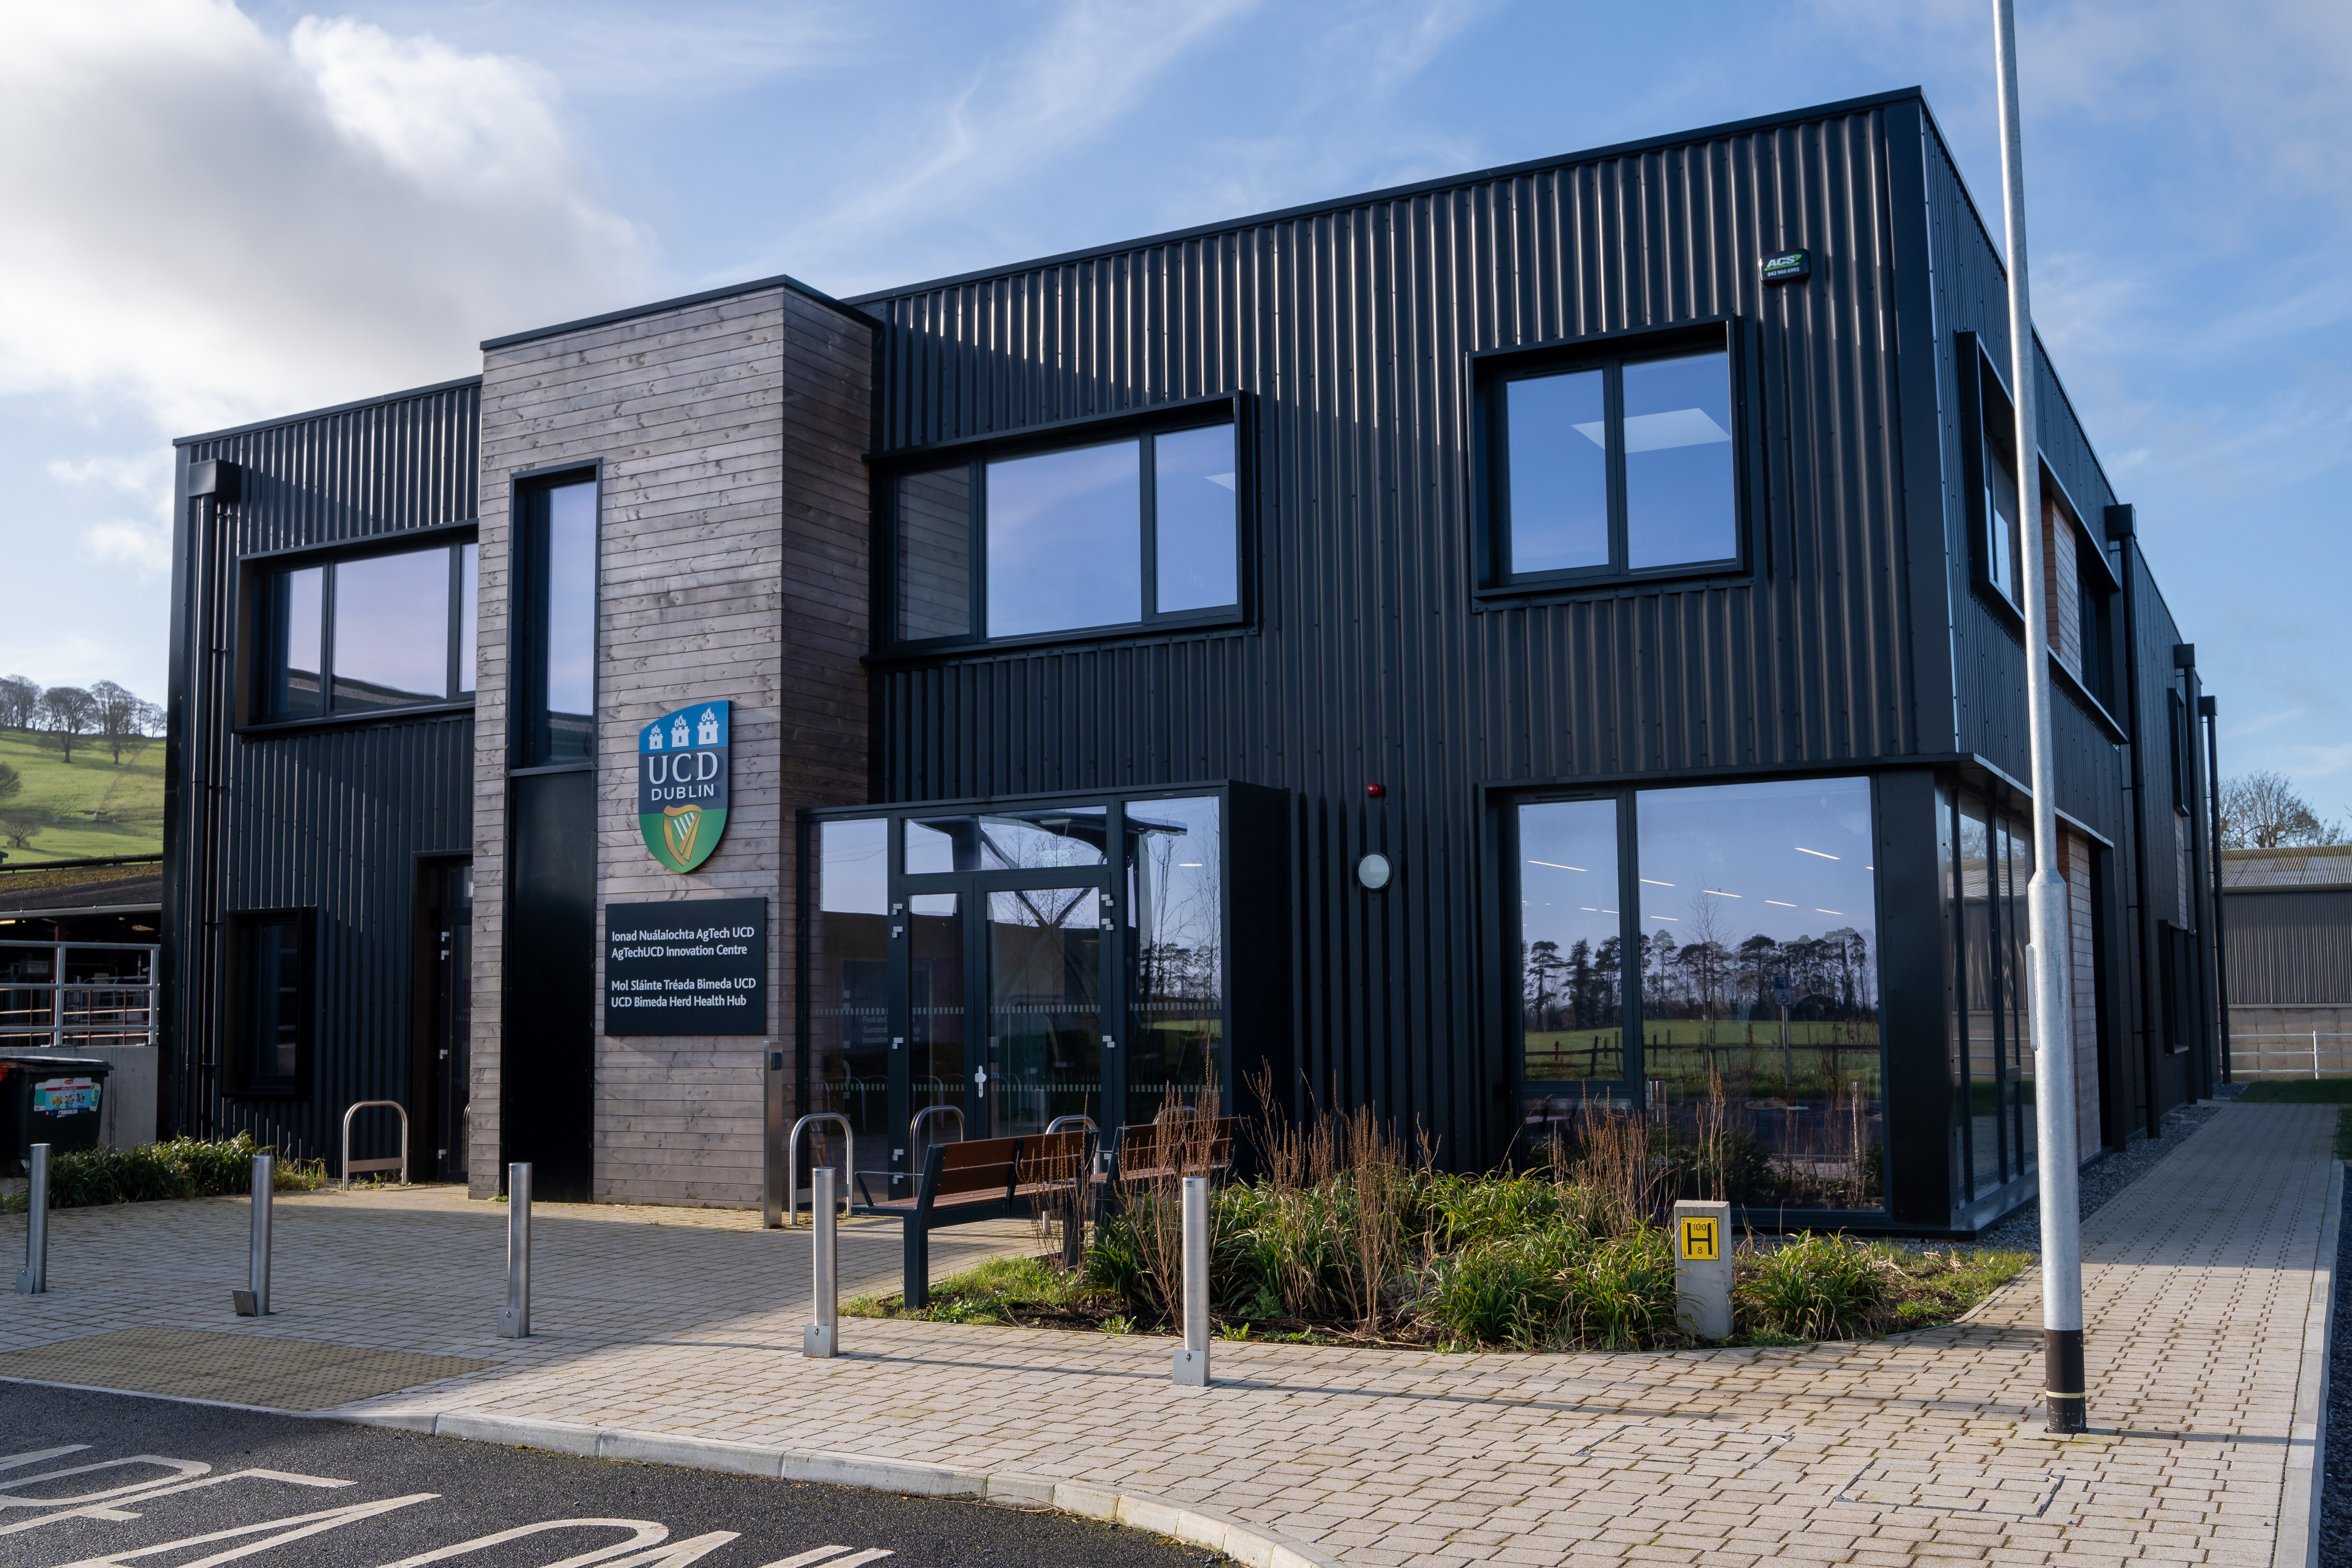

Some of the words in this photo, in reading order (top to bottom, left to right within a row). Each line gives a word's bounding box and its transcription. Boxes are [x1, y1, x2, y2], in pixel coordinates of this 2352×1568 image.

[1766, 256, 1796, 268] ACS
[647, 751, 719, 785] UCD
[651, 784, 715, 801] DUBLIN
[612, 930, 637, 942] Ionad
[639, 929, 694, 941] Nuálaíochta
[696, 927, 730, 942] AgTech
[732, 927, 755, 938] UCD
[611, 947, 664, 961] AgTechUCD
[666, 945, 715, 957] Innovation
[716, 944, 747, 955] Centre
[612, 980, 628, 991] Mol
[630, 979, 662, 991] Sláinte
[664, 979, 695, 990] Tréada
[697, 978, 731, 989] Bimeda
[734, 978, 756, 988] UCD
[611, 997, 632, 1008] UCD
[635, 996, 667, 1007] Bimeda
[669, 995, 691, 1007] Herd
[694, 995, 725, 1006] Health
[727, 994, 747, 1006] Hub
[1692, 1223, 1707, 1231] 100
[1686, 1222, 1713, 1255] H
